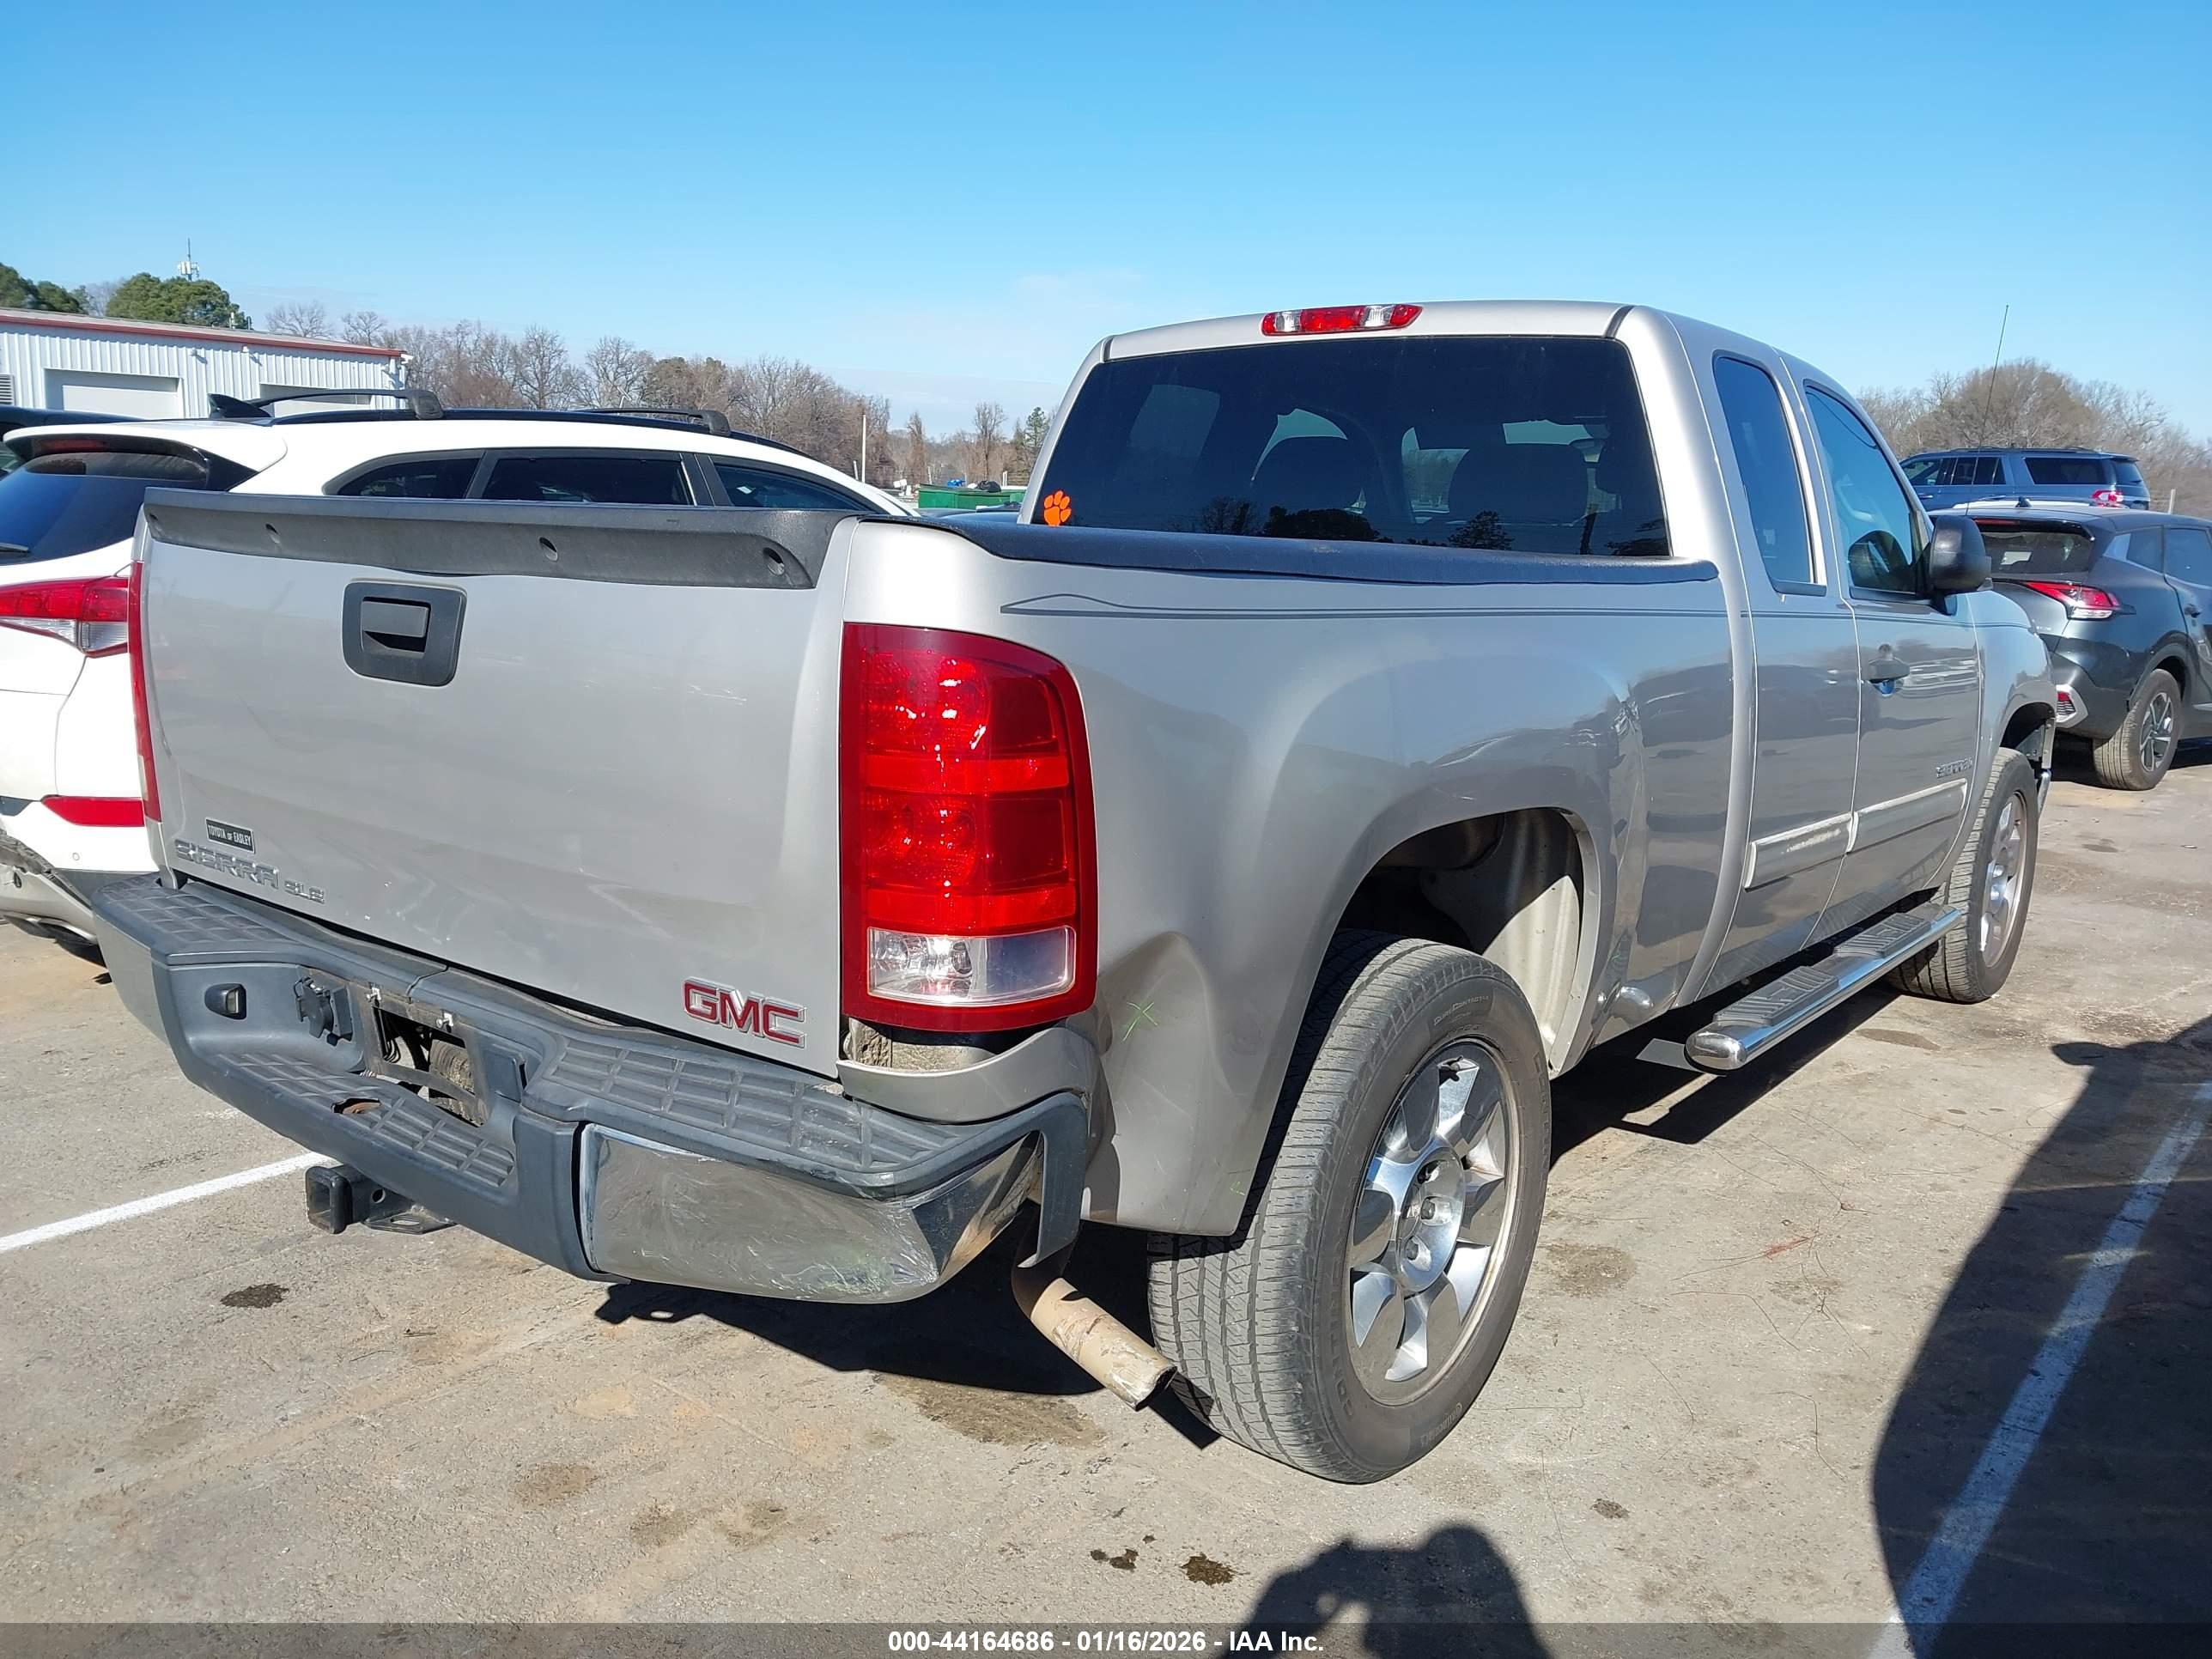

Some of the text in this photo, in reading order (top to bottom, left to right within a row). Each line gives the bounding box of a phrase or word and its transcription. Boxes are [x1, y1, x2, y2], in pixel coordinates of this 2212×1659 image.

[208, 823, 227, 839] TOYOTA
[233, 831, 252, 847] EASLEY
[174, 838, 325, 904] SIERRA SLE
[684, 977, 806, 1048] GMC
